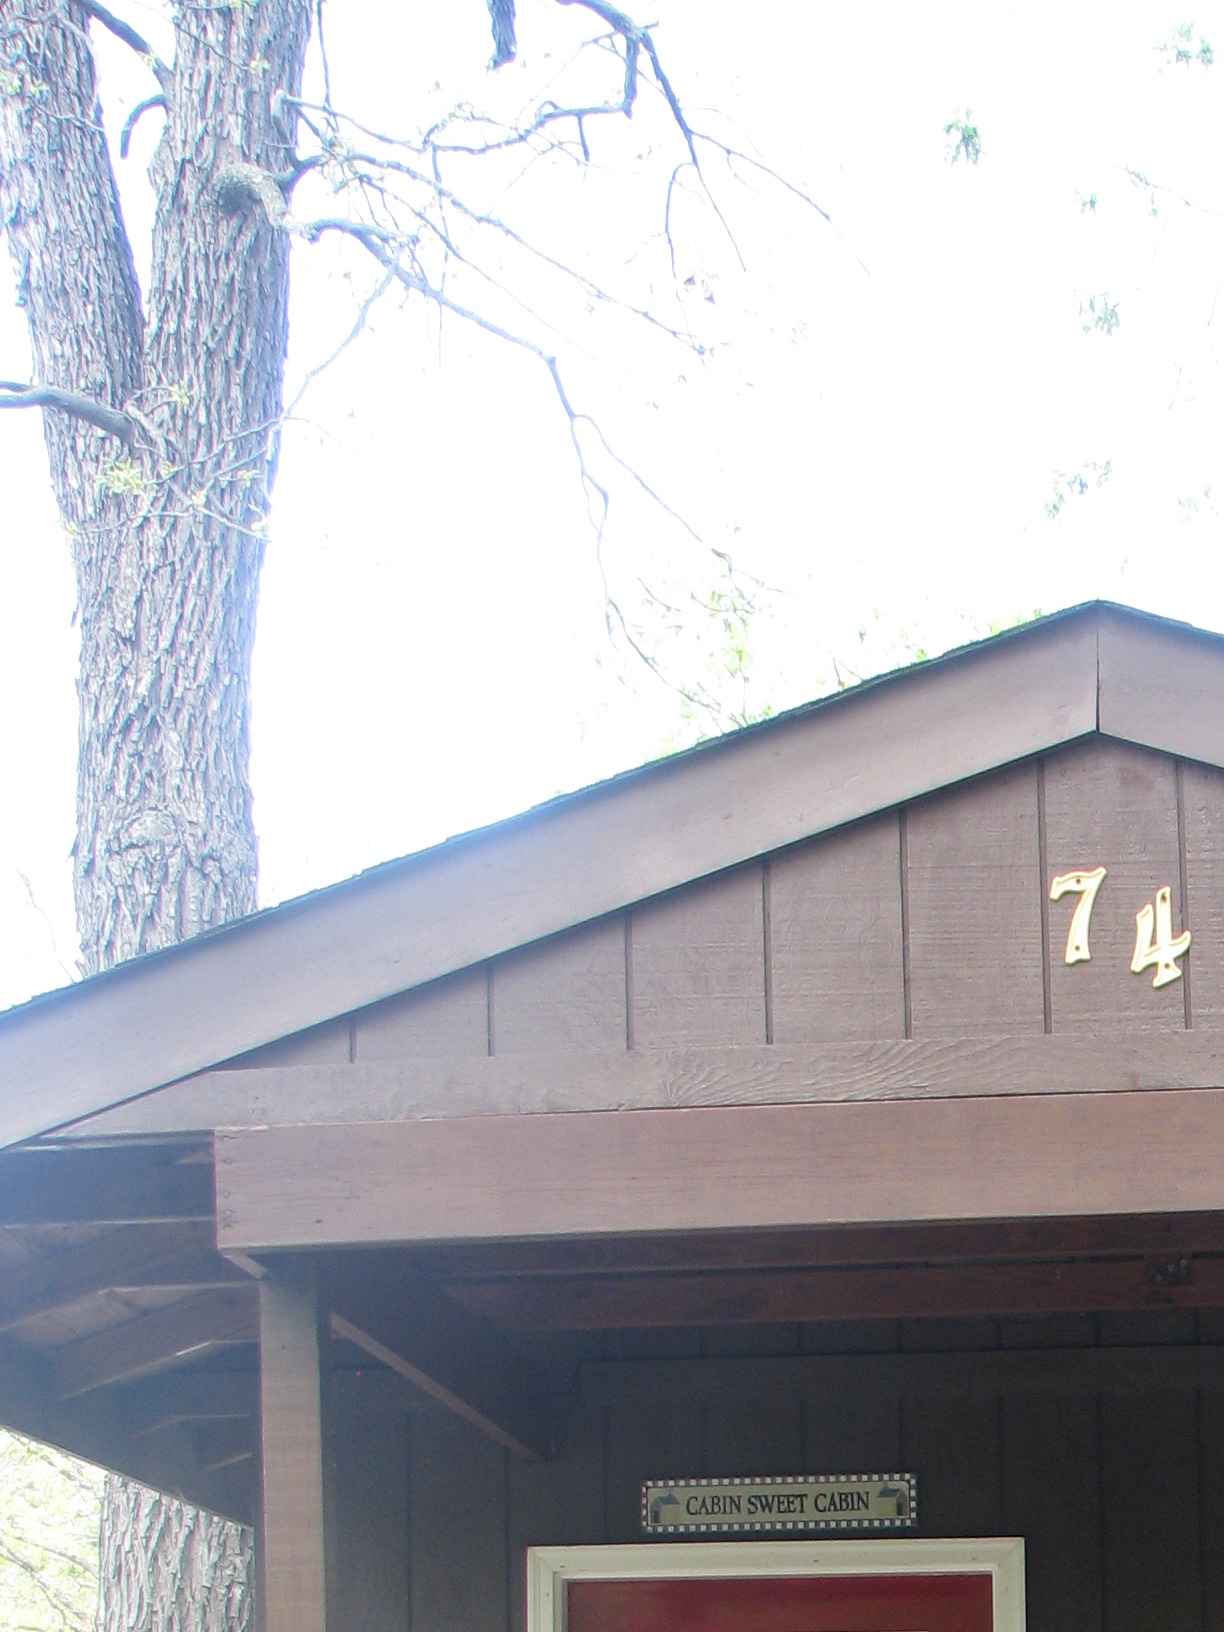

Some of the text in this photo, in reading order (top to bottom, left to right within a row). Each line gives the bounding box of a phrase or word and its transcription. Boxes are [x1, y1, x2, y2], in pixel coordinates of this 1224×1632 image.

[686, 1491, 870, 1515] CABIN SWEET CABIN
